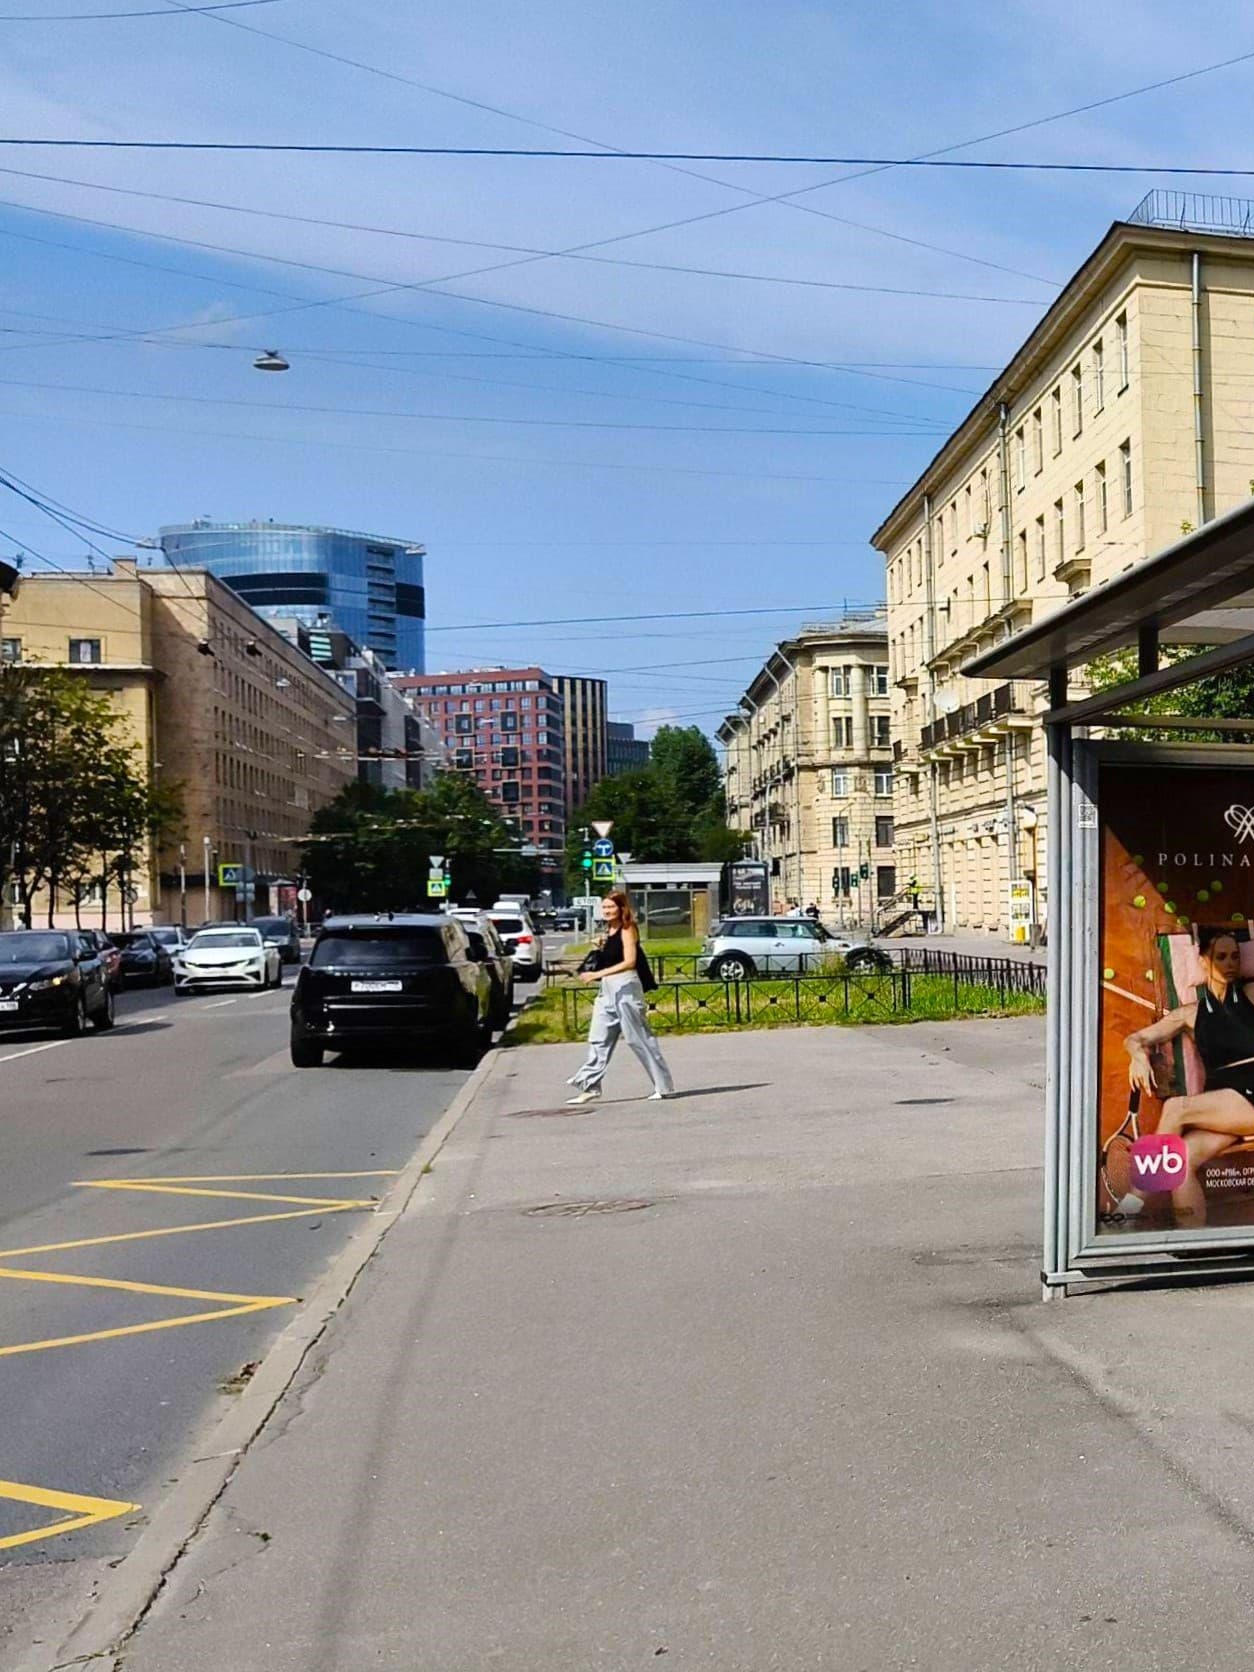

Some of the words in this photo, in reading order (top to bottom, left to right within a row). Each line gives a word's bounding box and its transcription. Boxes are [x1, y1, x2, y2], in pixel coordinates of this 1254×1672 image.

[1158, 853, 1251, 867] POLINA
[1134, 1144, 1183, 1175] wb
[1206, 1177, 1247, 1188] МОСКОВСКАЯ
